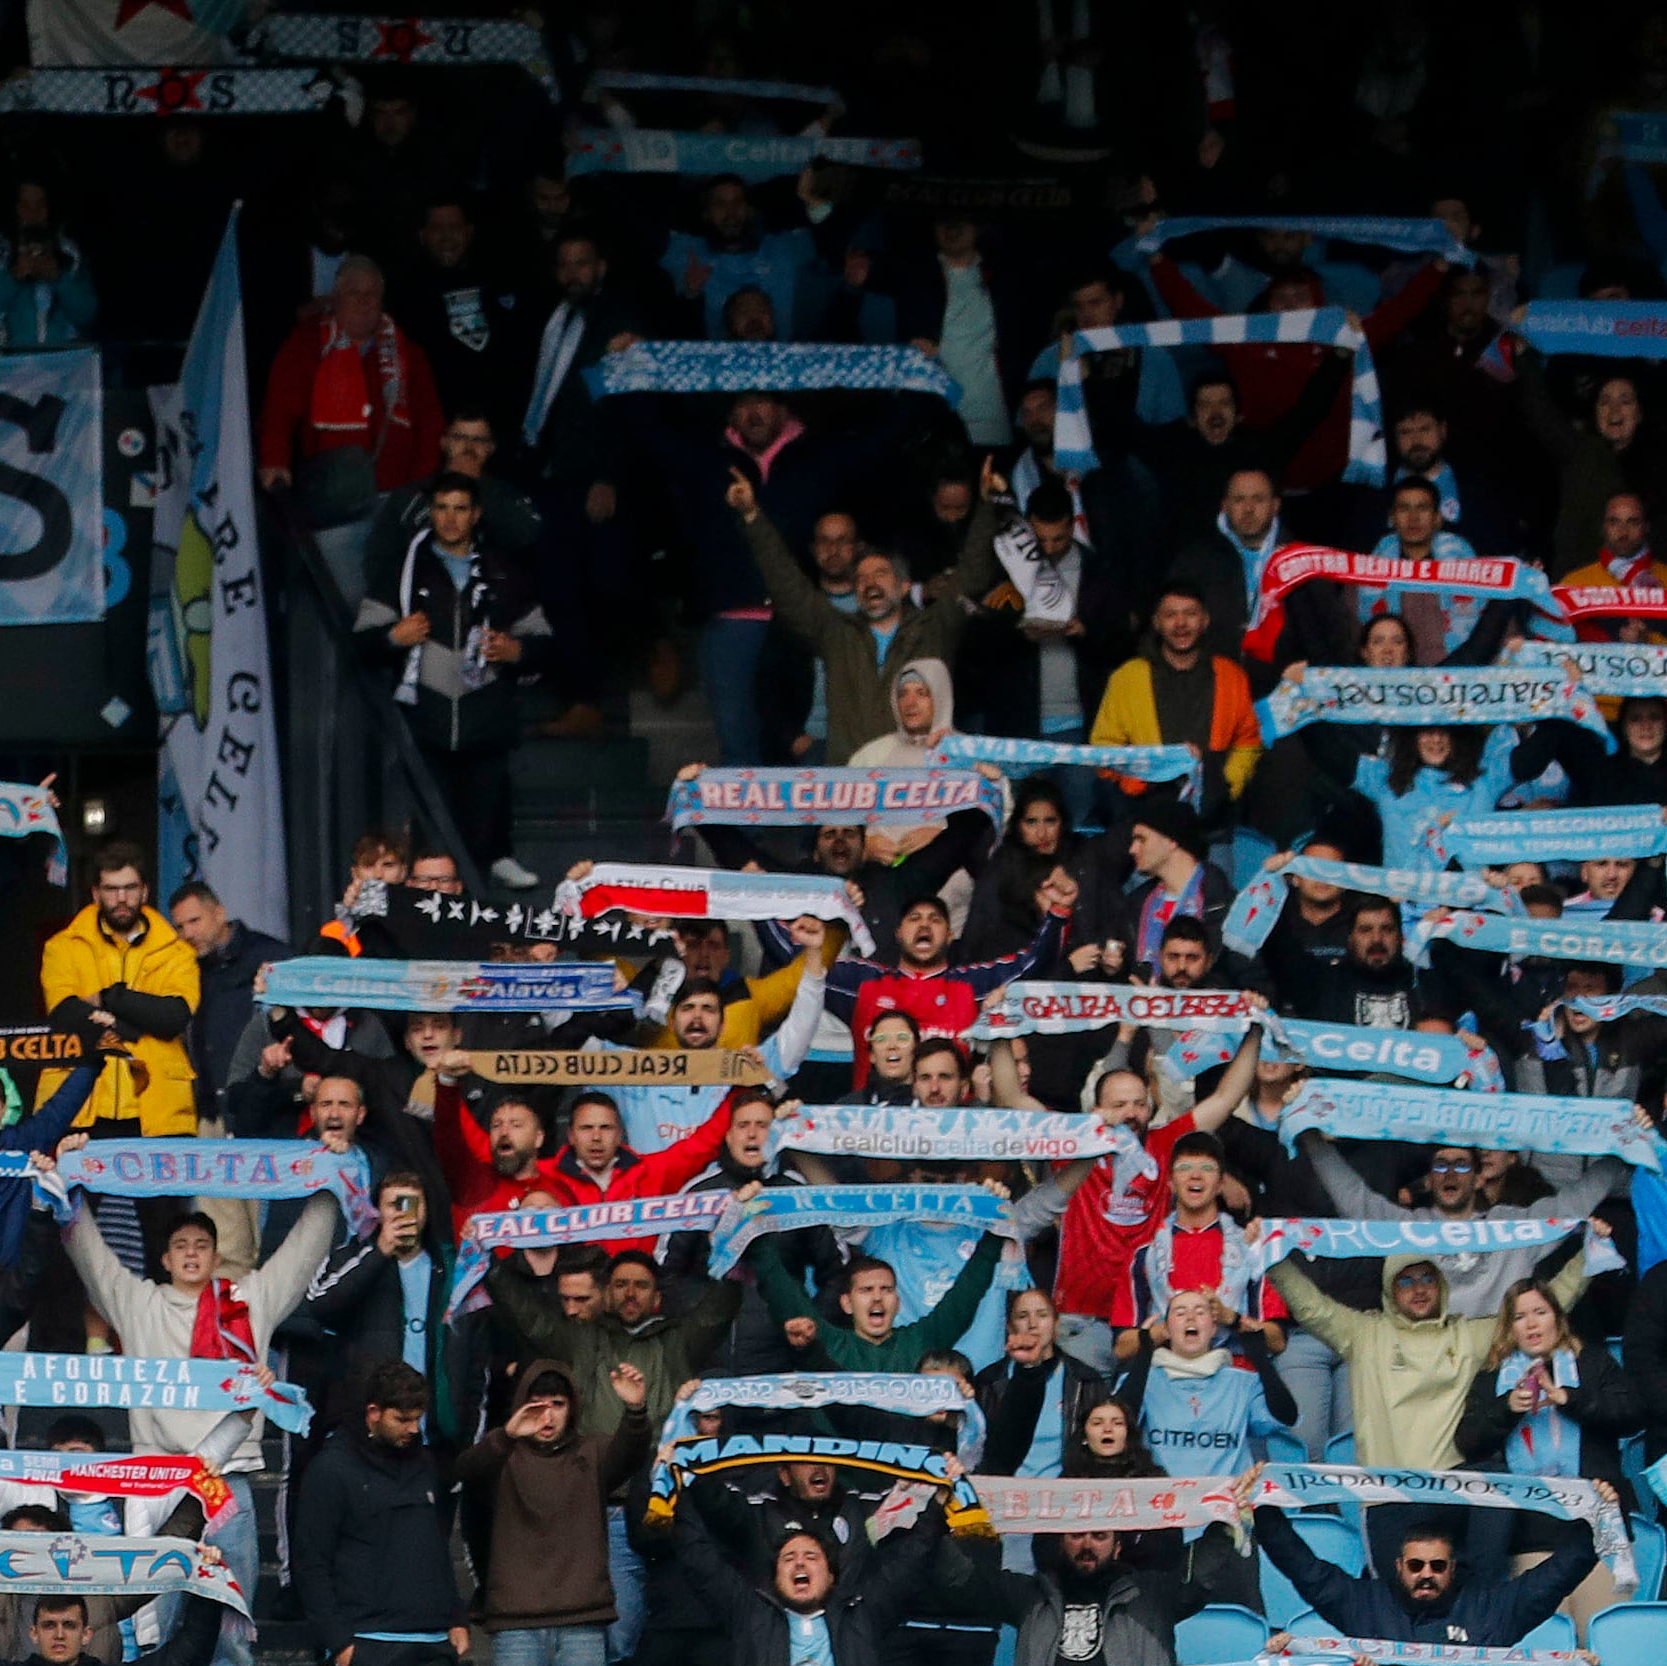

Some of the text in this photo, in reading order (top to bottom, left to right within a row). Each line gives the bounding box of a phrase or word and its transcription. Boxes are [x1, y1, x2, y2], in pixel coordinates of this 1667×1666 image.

[701, 778, 980, 811] REAL CLUB CELTA
[5, 1032, 81, 1061] CELTA
[111, 1152, 279, 1185] CELTA
[547, 1205, 636, 1236] CLUB
[24, 1356, 191, 1385] AFOUTEZA
[16, 1378, 201, 1408] E CORAZÓN
[23, 1463, 192, 1484] FINAL MANCHESTER UNITED
[1523, 1484, 1582, 1508] 1923
